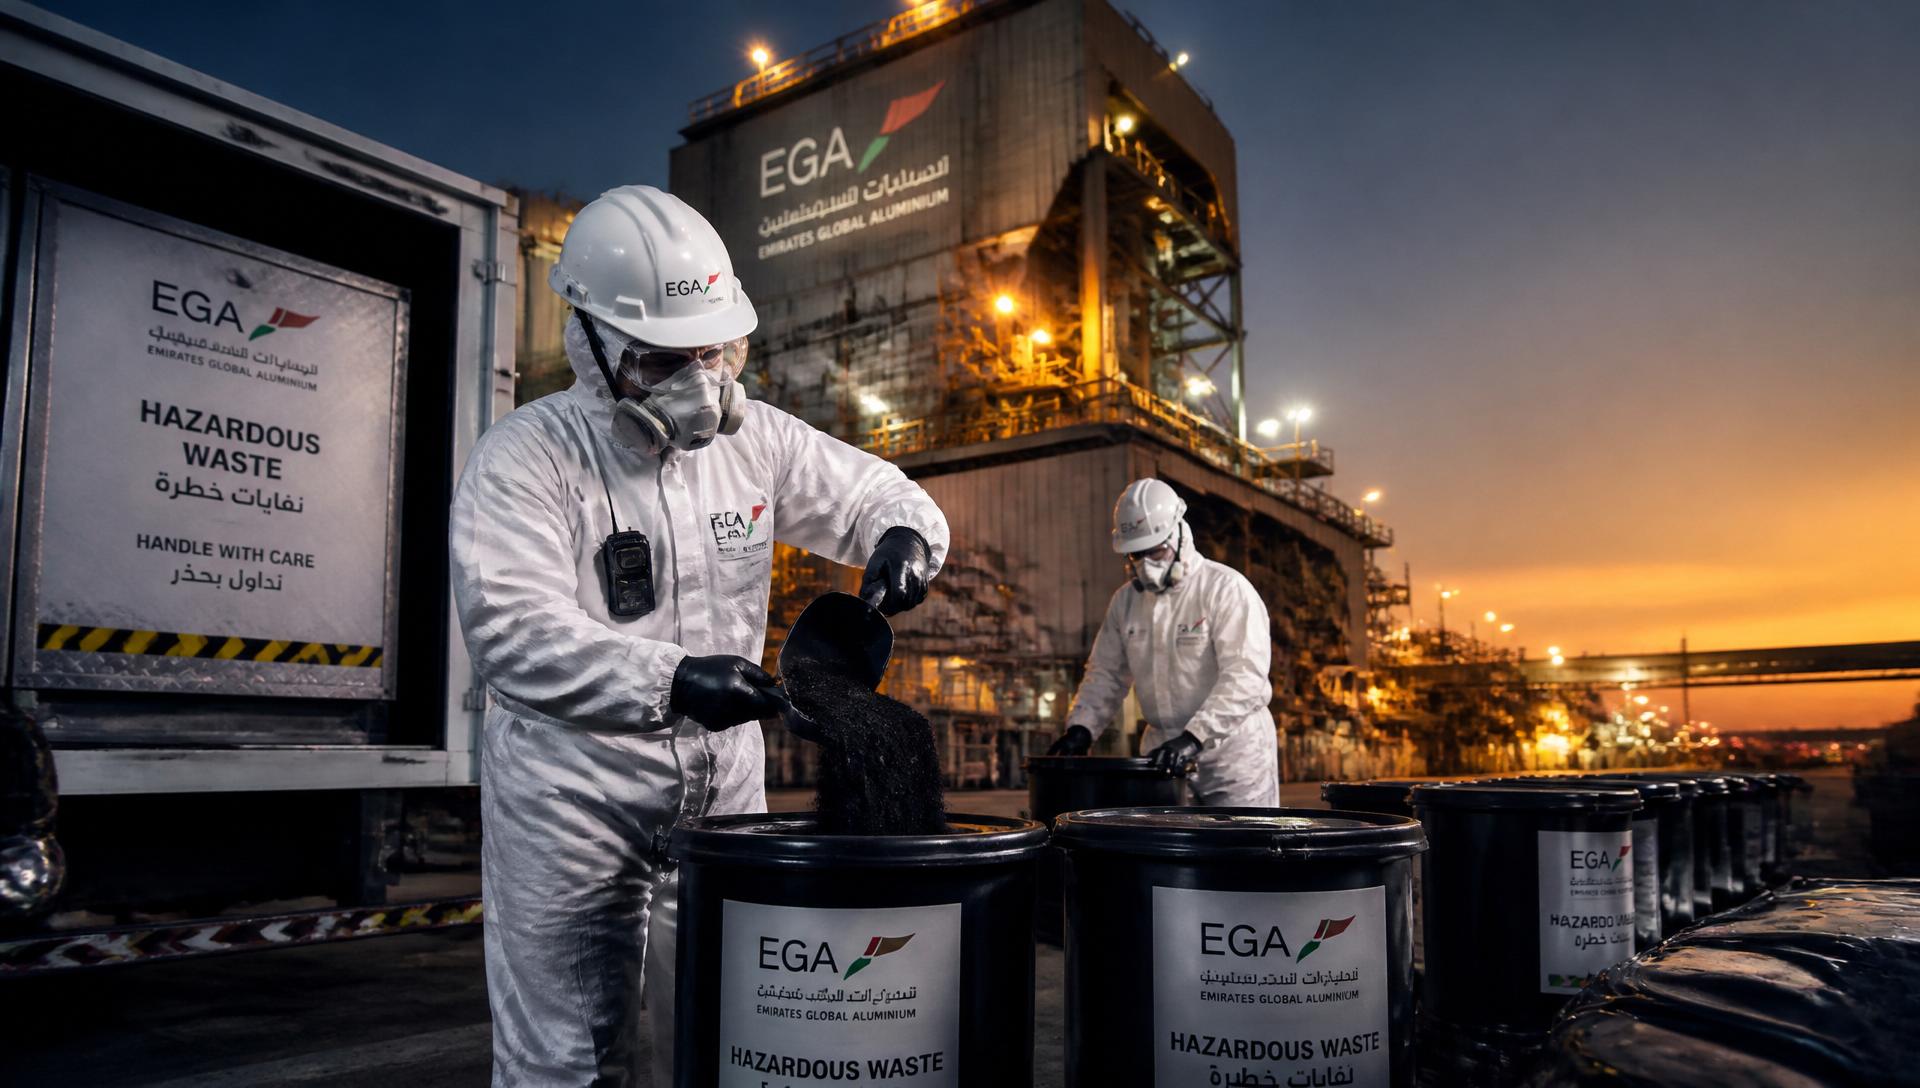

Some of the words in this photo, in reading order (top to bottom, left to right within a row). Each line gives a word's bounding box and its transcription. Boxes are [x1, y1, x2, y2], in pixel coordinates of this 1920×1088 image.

[760, 126, 855, 198] EGA
[758, 229, 815, 260] EMIRATES
[817, 214, 866, 242] GLOBAL
[869, 188, 949, 226] ALUMINIUM
[665, 279, 703, 297] EGA
[152, 280, 244, 333] EGA
[147, 345, 205, 366] EMIRATES
[208, 359, 252, 377] GLOBAL
[256, 371, 317, 392] ALUMINIUM
[140, 399, 320, 455] HAZARDOUS
[183, 441, 282, 480] WASTE
[155, 471, 225, 501] خطرة
[231, 488, 303, 515] نفايات
[136, 533, 213, 557] HANDLE
[219, 543, 264, 562] WITH
[269, 550, 315, 568] CARE
[170, 563, 222, 589] بحذر
[1570, 850, 1611, 870] EGA
[759, 935, 839, 974] EGA
[1200, 921, 1291, 958] EGA
[756, 1004, 802, 1019] EMIRATES
[805, 1010, 848, 1021] GLOBAL
[852, 1009, 916, 1021] ALUMINIUM
[1200, 991, 1255, 1004] EMIRATES
[1259, 994, 1303, 1004] GLOBAL
[731, 1045, 860, 1081] HAZARDOUS
[868, 1052, 944, 1080] WASTE
[1170, 1031, 1314, 1061] HAZARDOUS
[1320, 1031, 1380, 1059] WASTE
